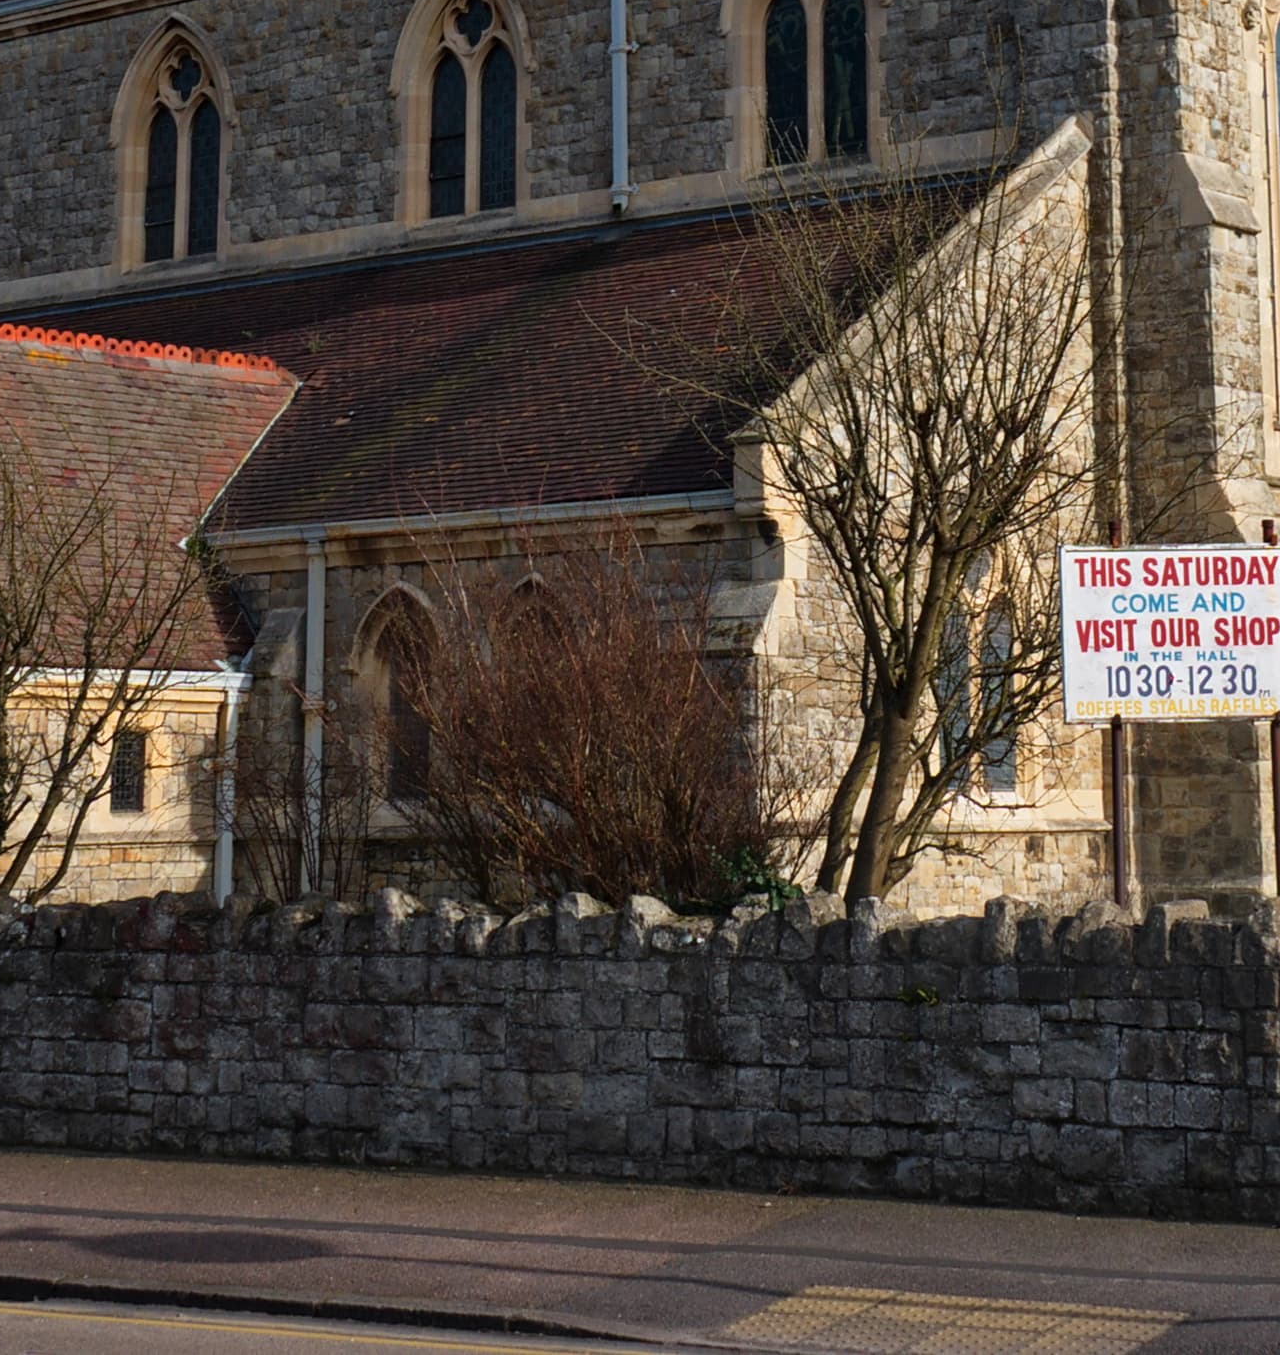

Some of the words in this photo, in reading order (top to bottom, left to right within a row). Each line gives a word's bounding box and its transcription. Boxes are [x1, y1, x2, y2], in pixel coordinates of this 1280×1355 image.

[1074, 557, 1132, 587] THIS
[1142, 556, 1279, 587] SATURDAY
[1111, 593, 1179, 614] COME
[1191, 592, 1245, 612] AND
[1075, 619, 1137, 652] VISIT
[1151, 618, 1200, 647] OUR
[1214, 615, 1280, 646] SHOP
[1124, 652, 1138, 662] IN
[1150, 651, 1182, 662] THE
[1196, 650, 1237, 661] HALL
[1149, 698, 1205, 715] STALLS
[1210, 696, 1278, 714] RAFFLES
